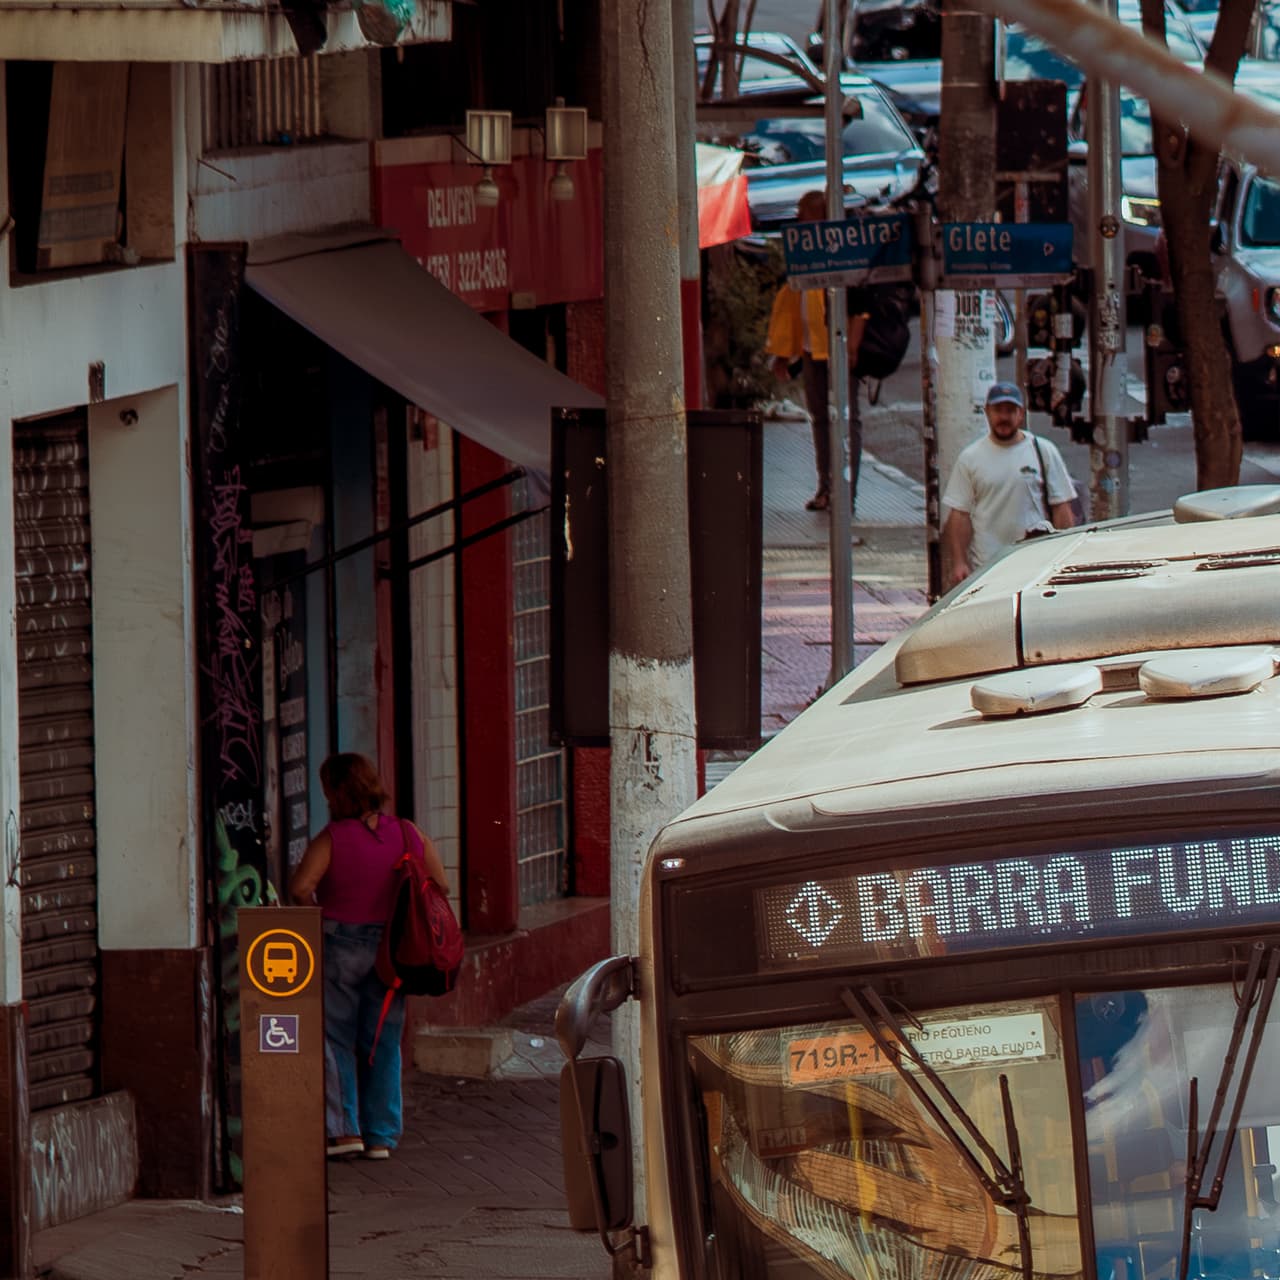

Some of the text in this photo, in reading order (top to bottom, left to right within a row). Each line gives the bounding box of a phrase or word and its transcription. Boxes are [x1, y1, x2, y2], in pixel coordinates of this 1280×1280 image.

[427, 185, 476, 228] DELIVERY
[786, 221, 901, 254] Palmeiras
[949, 225, 1011, 252] Glete
[857, 855, 1091, 943] BARRA
[933, 1025, 992, 1040] PEQUENO
[919, 1041, 1042, 1062] ETRÔ BARRA FUNDA
